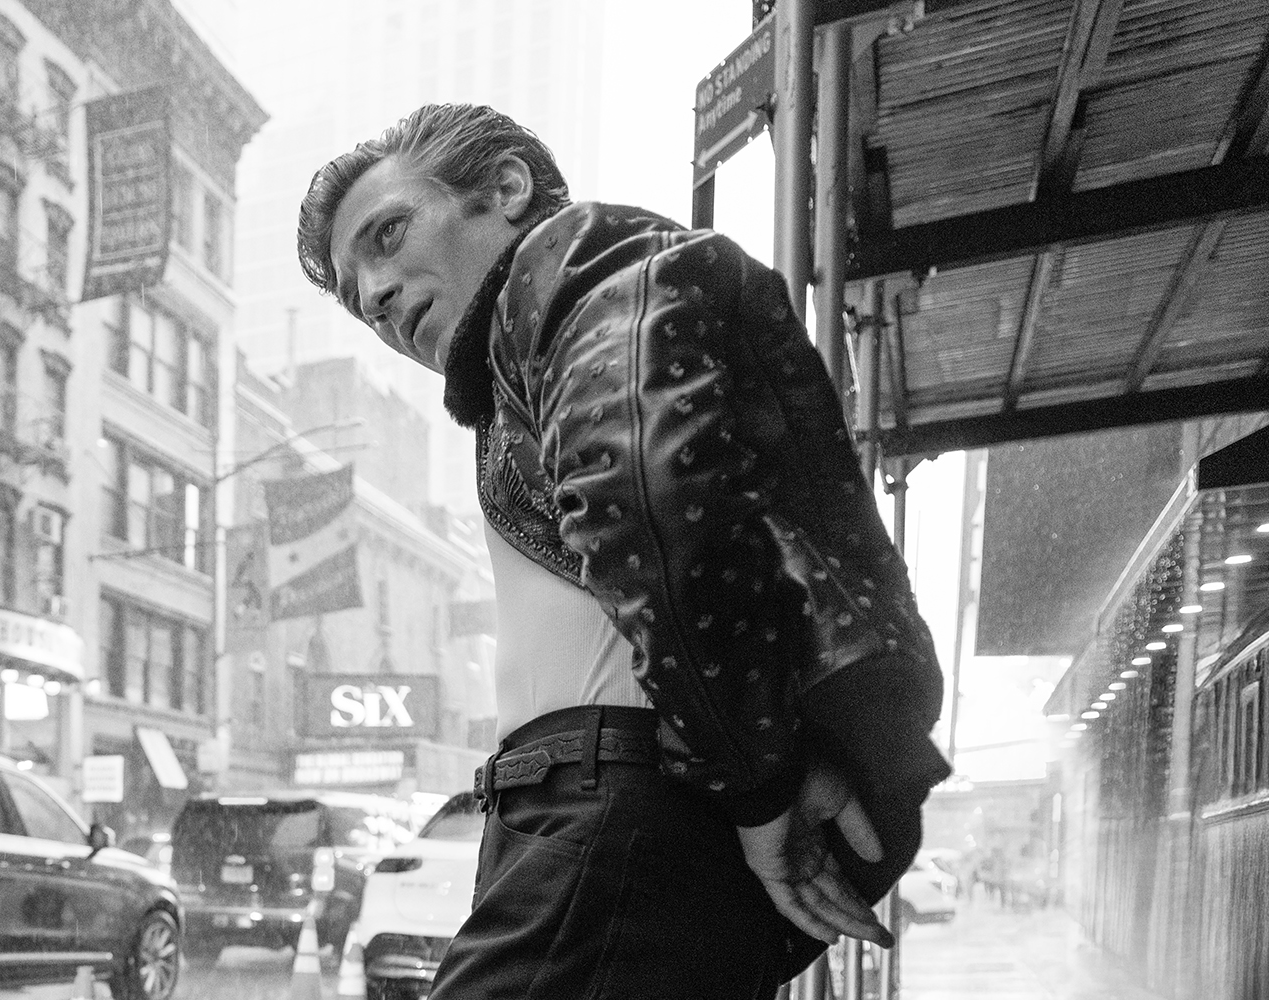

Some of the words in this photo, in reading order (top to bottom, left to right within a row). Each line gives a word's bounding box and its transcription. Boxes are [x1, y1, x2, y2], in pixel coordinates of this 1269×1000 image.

[698, 83, 714, 110] NO
[715, 31, 771, 95] STANDING
[698, 86, 742, 136] Anytime
